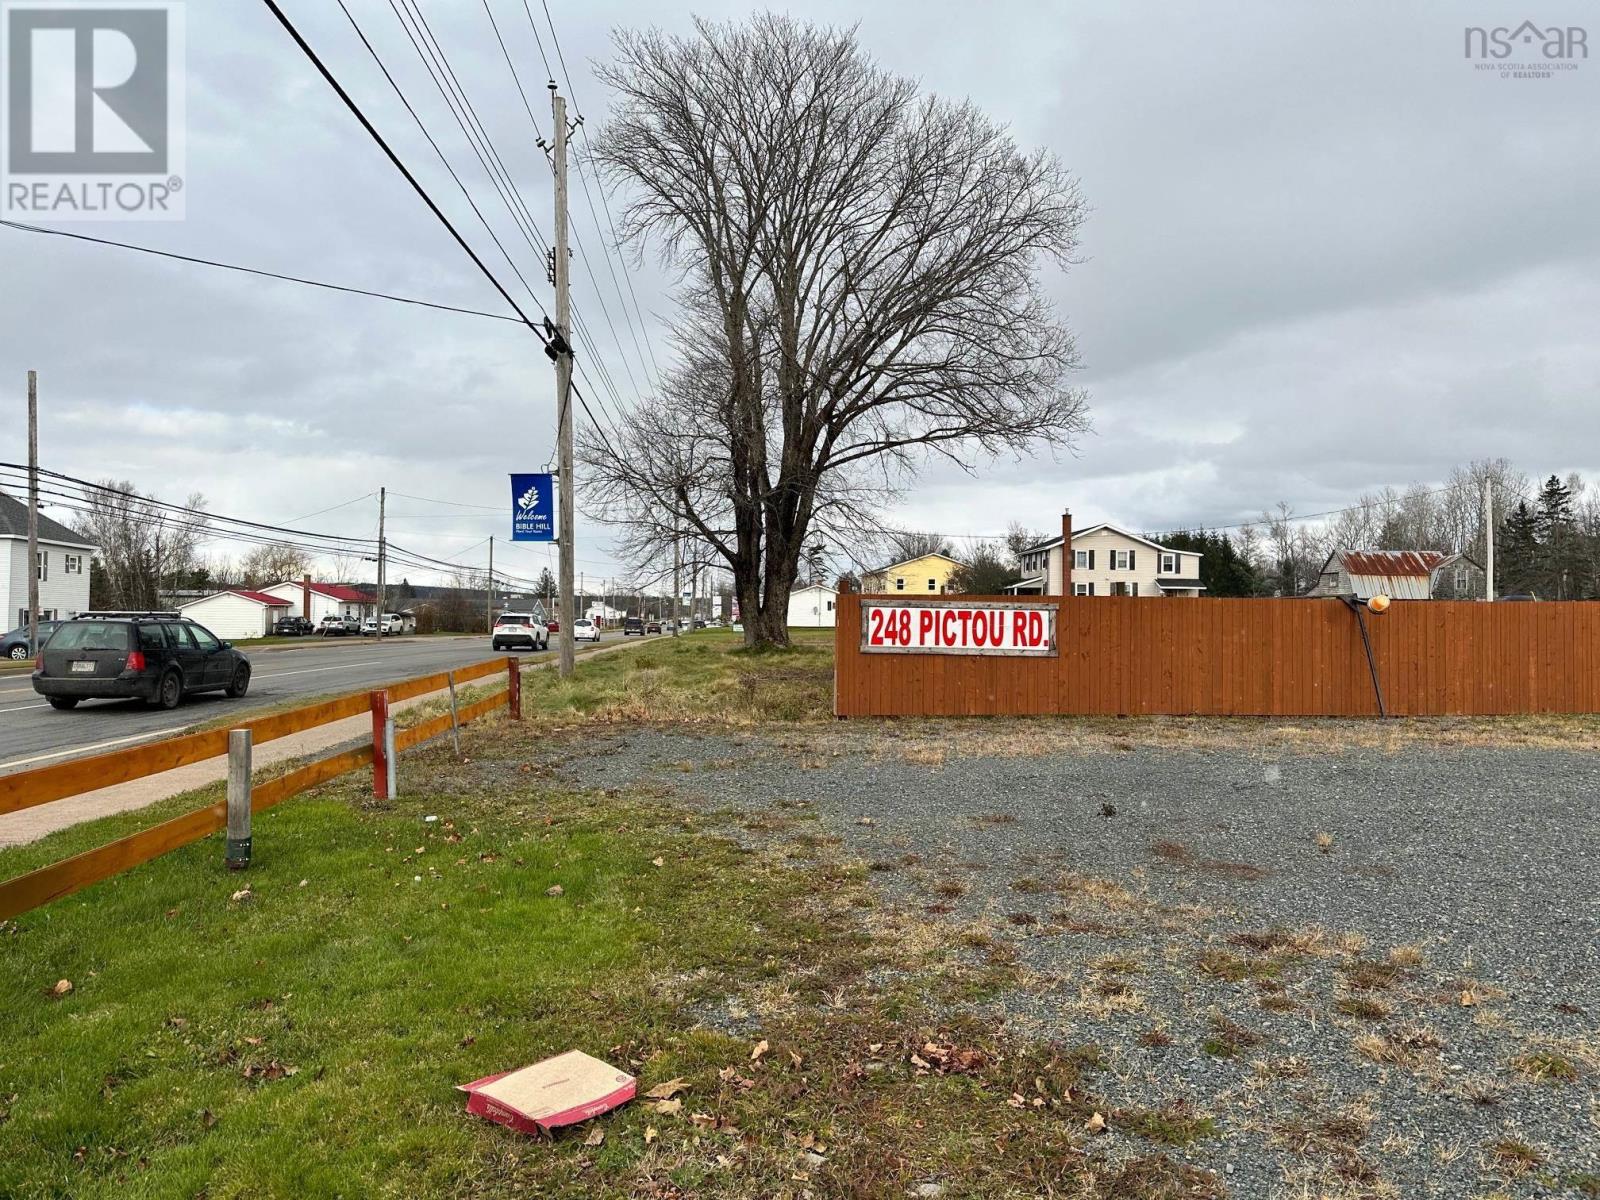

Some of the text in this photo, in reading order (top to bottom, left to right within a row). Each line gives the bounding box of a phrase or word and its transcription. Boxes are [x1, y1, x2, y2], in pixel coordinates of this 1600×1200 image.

[516, 510, 547, 521] Welcome
[870, 608, 1049, 647] 248 PICTOU RD.
